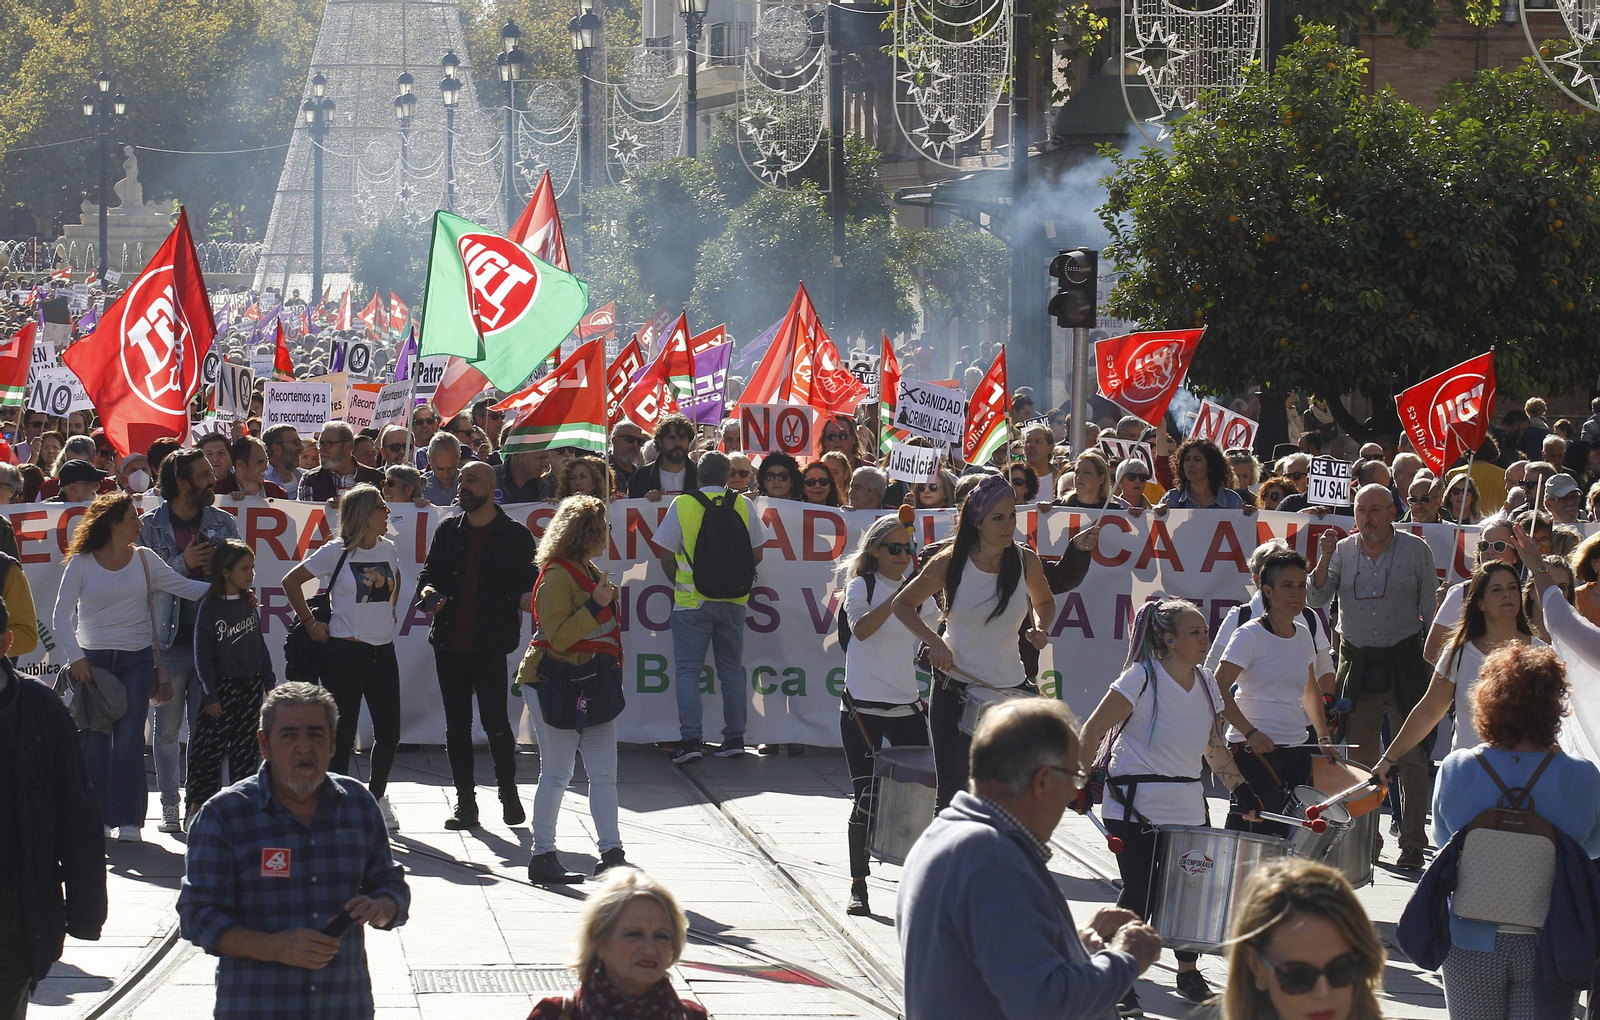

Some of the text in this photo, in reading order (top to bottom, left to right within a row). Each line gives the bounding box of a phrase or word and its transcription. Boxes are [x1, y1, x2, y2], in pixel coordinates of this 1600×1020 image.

[31, 379, 72, 415] NO
[268, 389, 311, 406] ¡Recortemos
[312, 394, 321, 406] ya
[918, 391, 963, 418] SANIDAD,
[268, 409, 326, 423] los recortadores!
[347, 412, 356, 425] los
[908, 410, 961, 437] CRIMEN LEGAL!
[1193, 403, 1251, 451] NO
[741, 406, 810, 455] NO
[891, 450, 938, 476] ¡Justicia!
[1312, 460, 1328, 475] SE
[1313, 479, 1327, 498] TU
